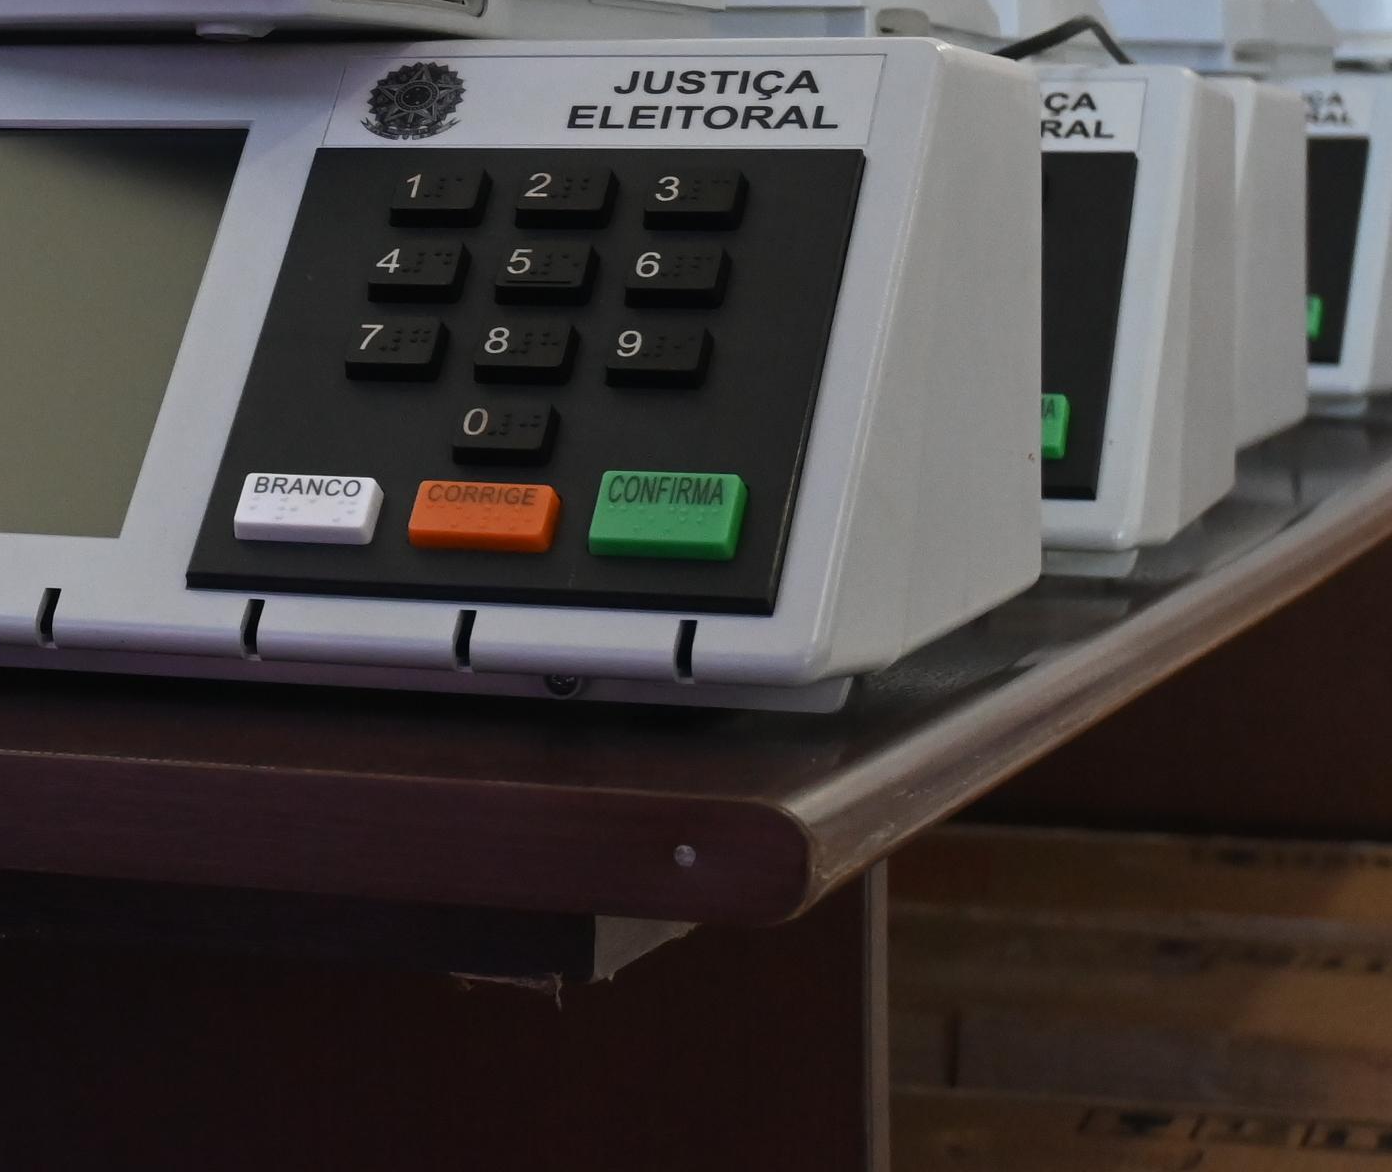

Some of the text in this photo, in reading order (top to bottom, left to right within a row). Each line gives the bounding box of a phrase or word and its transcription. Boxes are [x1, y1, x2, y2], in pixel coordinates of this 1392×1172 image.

[613, 69, 820, 101] JUSTIÇA
[566, 105, 839, 130] ELEITORAL
[406, 172, 680, 202] 1 2 3
[375, 248, 661, 278] 4 5 6
[359, 324, 643, 357] 7 8 9
[462, 408, 489, 436] 0
[253, 475, 724, 506] BRANCO CORRIGE CONFIRMA
